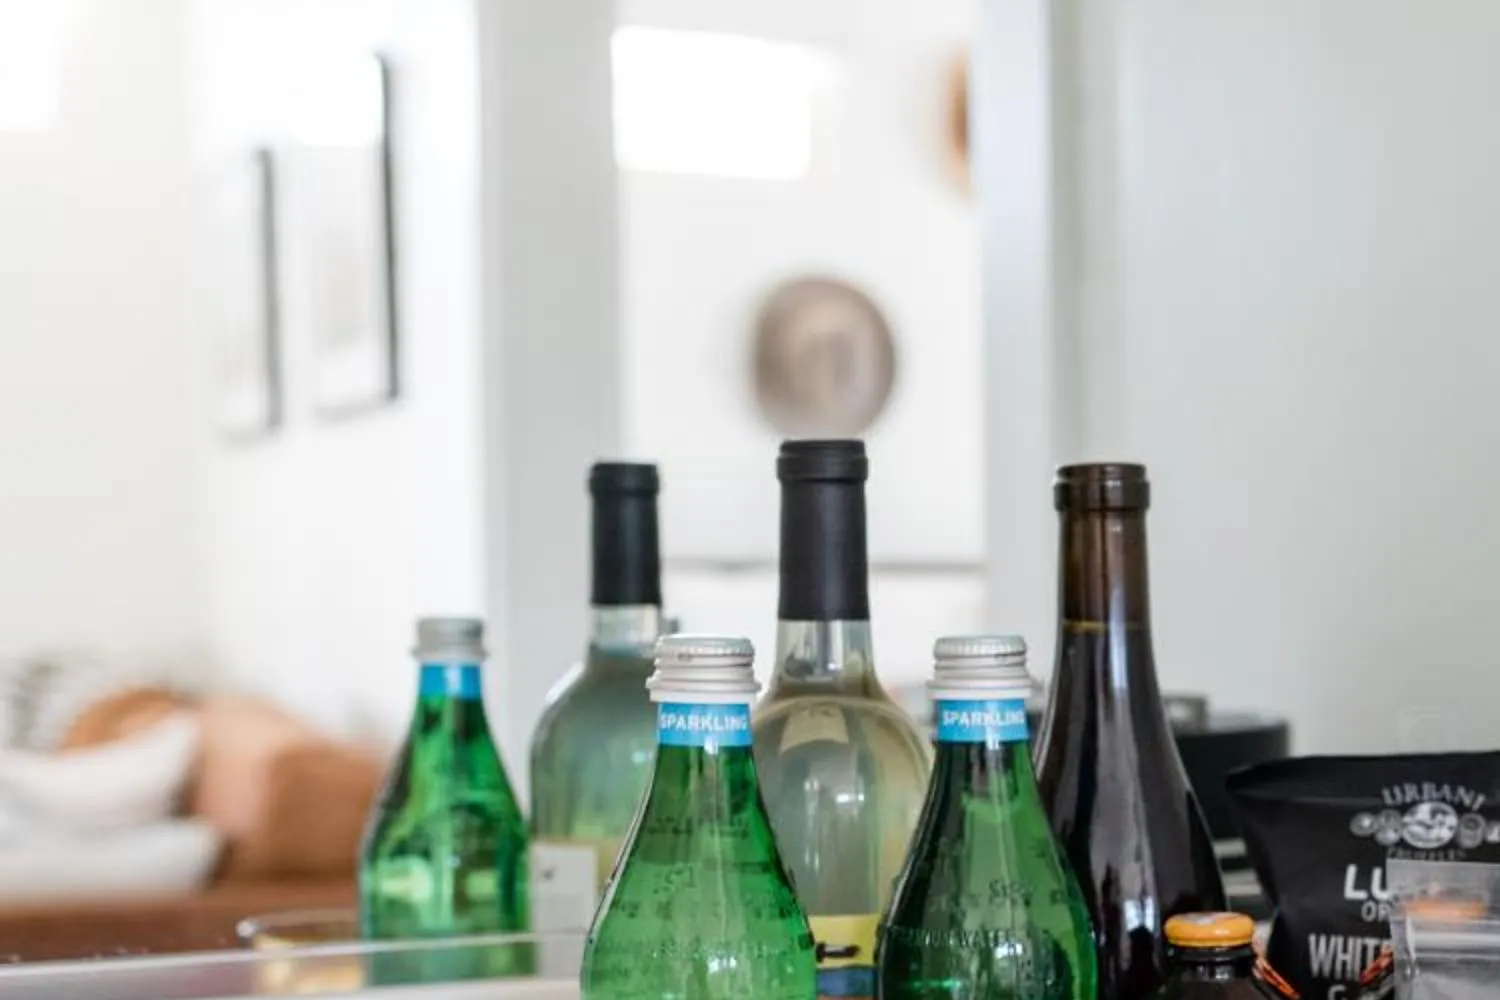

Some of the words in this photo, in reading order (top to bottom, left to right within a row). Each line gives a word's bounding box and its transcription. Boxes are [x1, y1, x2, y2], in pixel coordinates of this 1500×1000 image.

[1382, 782, 1486, 811] URBANI
[1344, 864, 1394, 899] LU
[1361, 901, 1392, 922] OR
